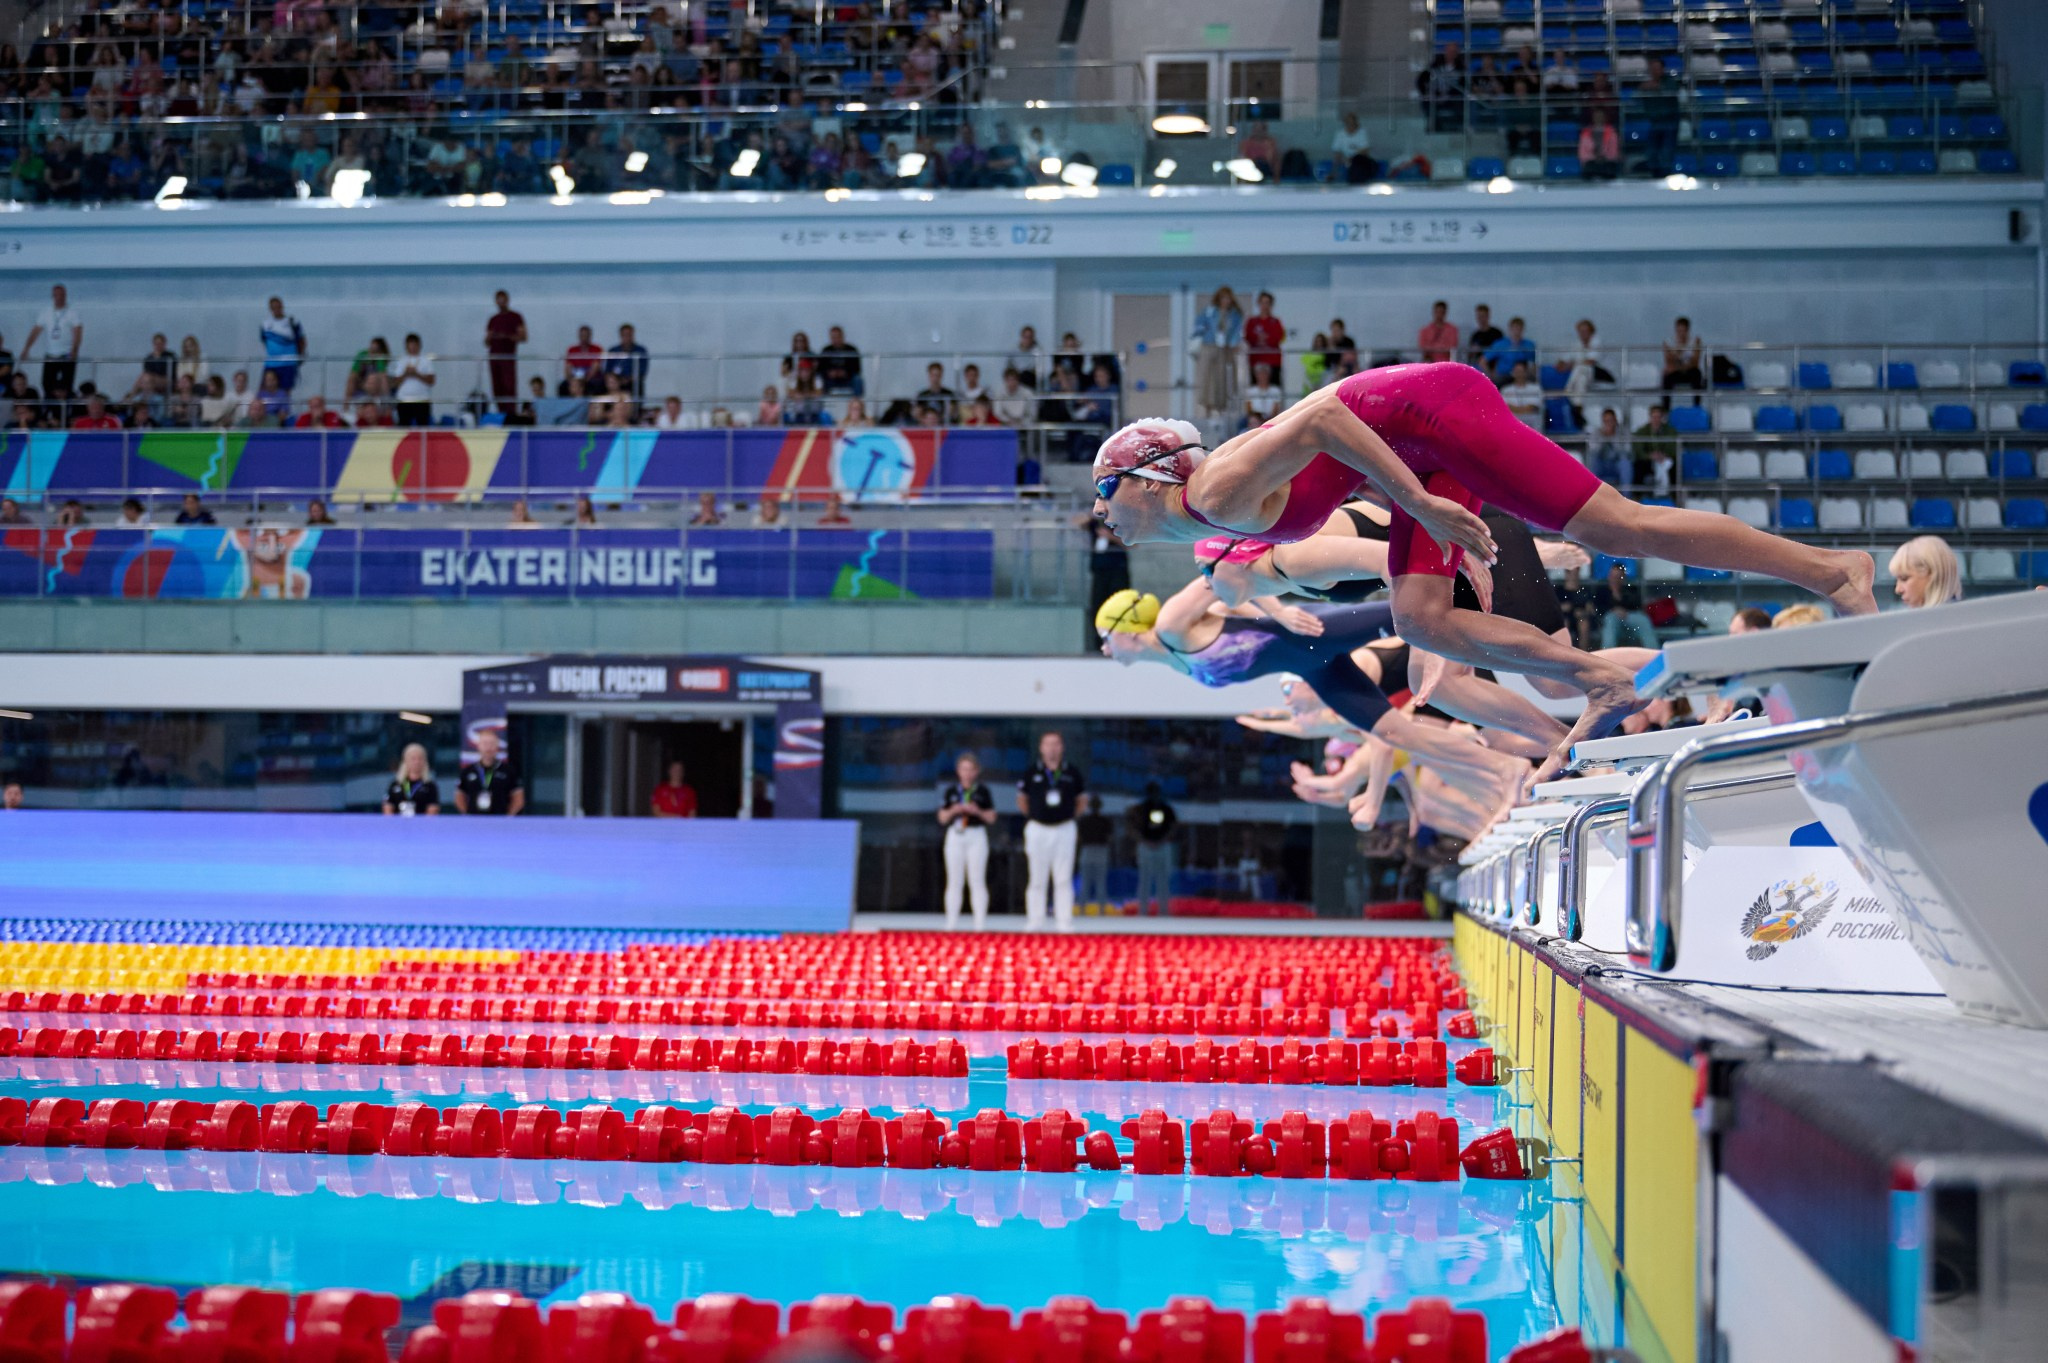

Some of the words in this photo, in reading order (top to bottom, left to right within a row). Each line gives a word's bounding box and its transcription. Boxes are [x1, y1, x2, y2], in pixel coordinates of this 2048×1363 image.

[1011, 224, 1053, 245] D22
[1333, 220, 1372, 242] D21
[421, 549, 717, 586] EKATERNBURG
[1843, 896, 1886, 914] МИН
[1826, 920, 1906, 941] РОССИЙС
